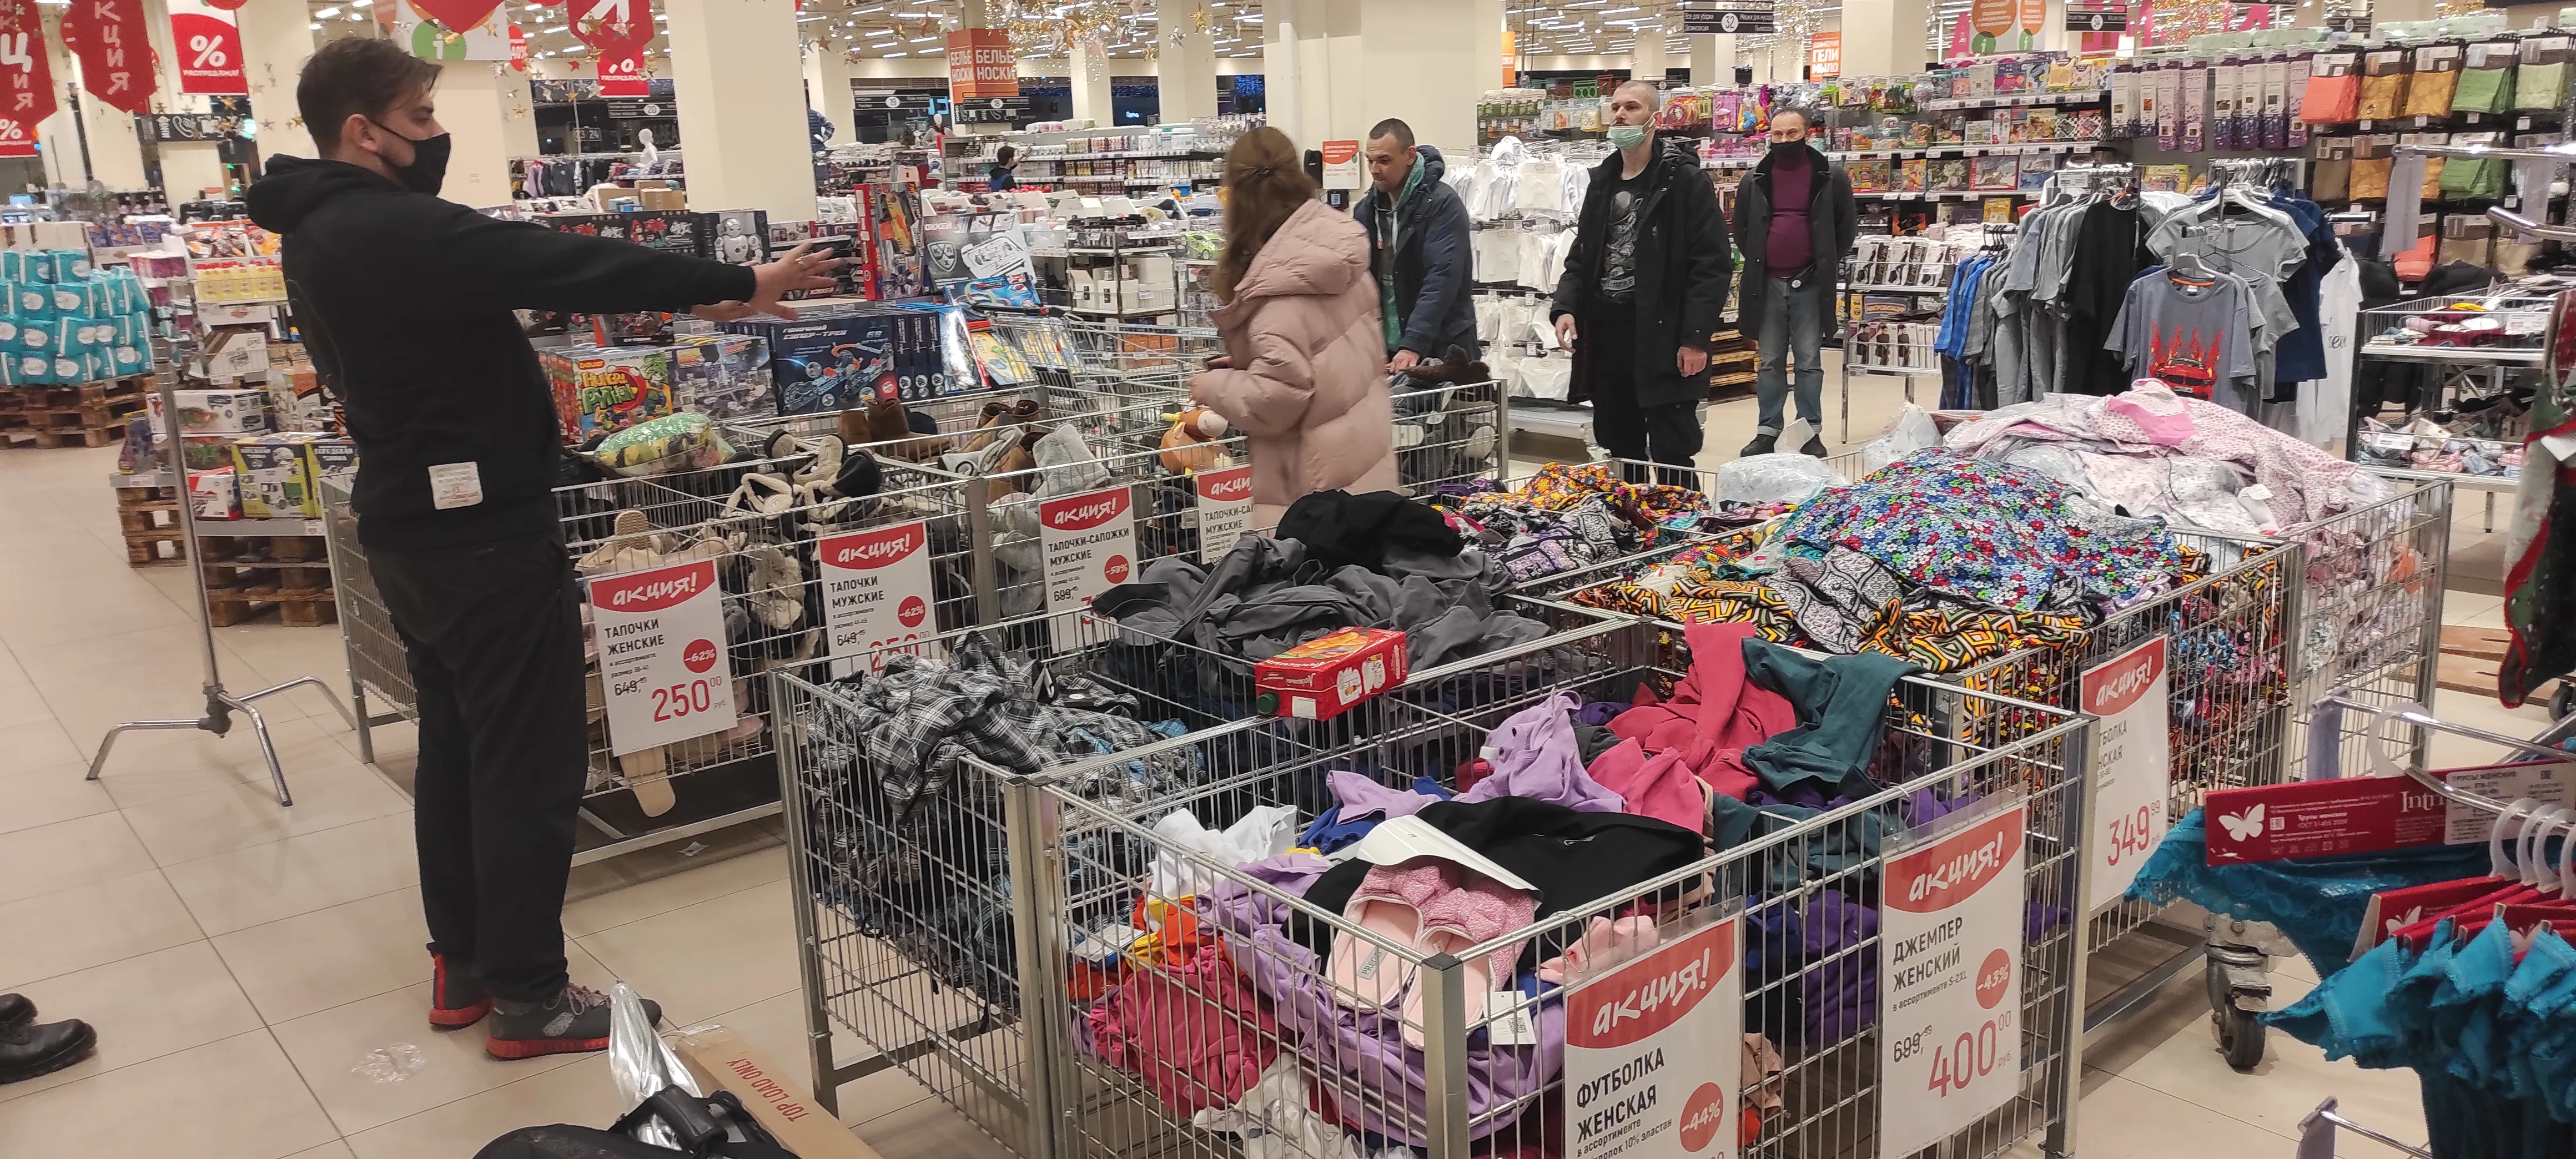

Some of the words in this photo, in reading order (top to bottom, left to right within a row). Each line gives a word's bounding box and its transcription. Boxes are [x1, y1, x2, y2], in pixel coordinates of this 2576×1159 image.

[1725, 16, 1734, 29] 32
[93, 1, 131, 95] кция
[975, 49, 1013, 64] БЕЛЬЕ
[1812, 48, 1839, 63] ГЕЛИ
[976, 66, 1017, 80] НОСКИ
[1210, 476, 1254, 495] акци
[1205, 519, 1244, 535] МУЖСКИЕ
[1048, 527, 1130, 553] ТАПОЧКИ-САПОЖКИ
[1049, 549, 1093, 567] МУЖСКИЕ
[829, 576, 879, 593] ТАПОЧКИ
[832, 590, 885, 609] МУЖСКИЕ
[899, 604, 924, 617] -62%
[604, 618, 660, 639] ТАПОЧКИ
[607, 634, 665, 656] ЖЕНСКИЕ
[685, 648, 716, 662] -62%
[651, 679, 710, 722] 250
[2107, 805, 2150, 867] 349
[1893, 916, 1964, 966] ДЖЕМПЕР
[1361, 951, 1382, 976] PREGO
[1893, 942, 1961, 993] ЖЕНСКИЙ
[1976, 964, 2009, 991] -43%
[1899, 981, 1948, 1007] ассортименте
[1928, 1020, 1996, 1098] 400
[1999, 1010, 2011, 1031] 00
[726, 1058, 763, 1080] ONLY
[1576, 1047, 1665, 1110] ФУТБОЛКА
[751, 1079, 790, 1103] LOAD
[777, 1102, 811, 1122] TOP
[1576, 1084, 1657, 1145] ЖЕНСКАЯ
[1682, 1098, 1721, 1133] -44%
[1577, 1148, 1582, 1158] в
[1583, 1118, 1641, 1155] ассортименте
[1624, 1133, 1639, 1150] 10%
[1641, 1118, 1672, 1142] эластан
